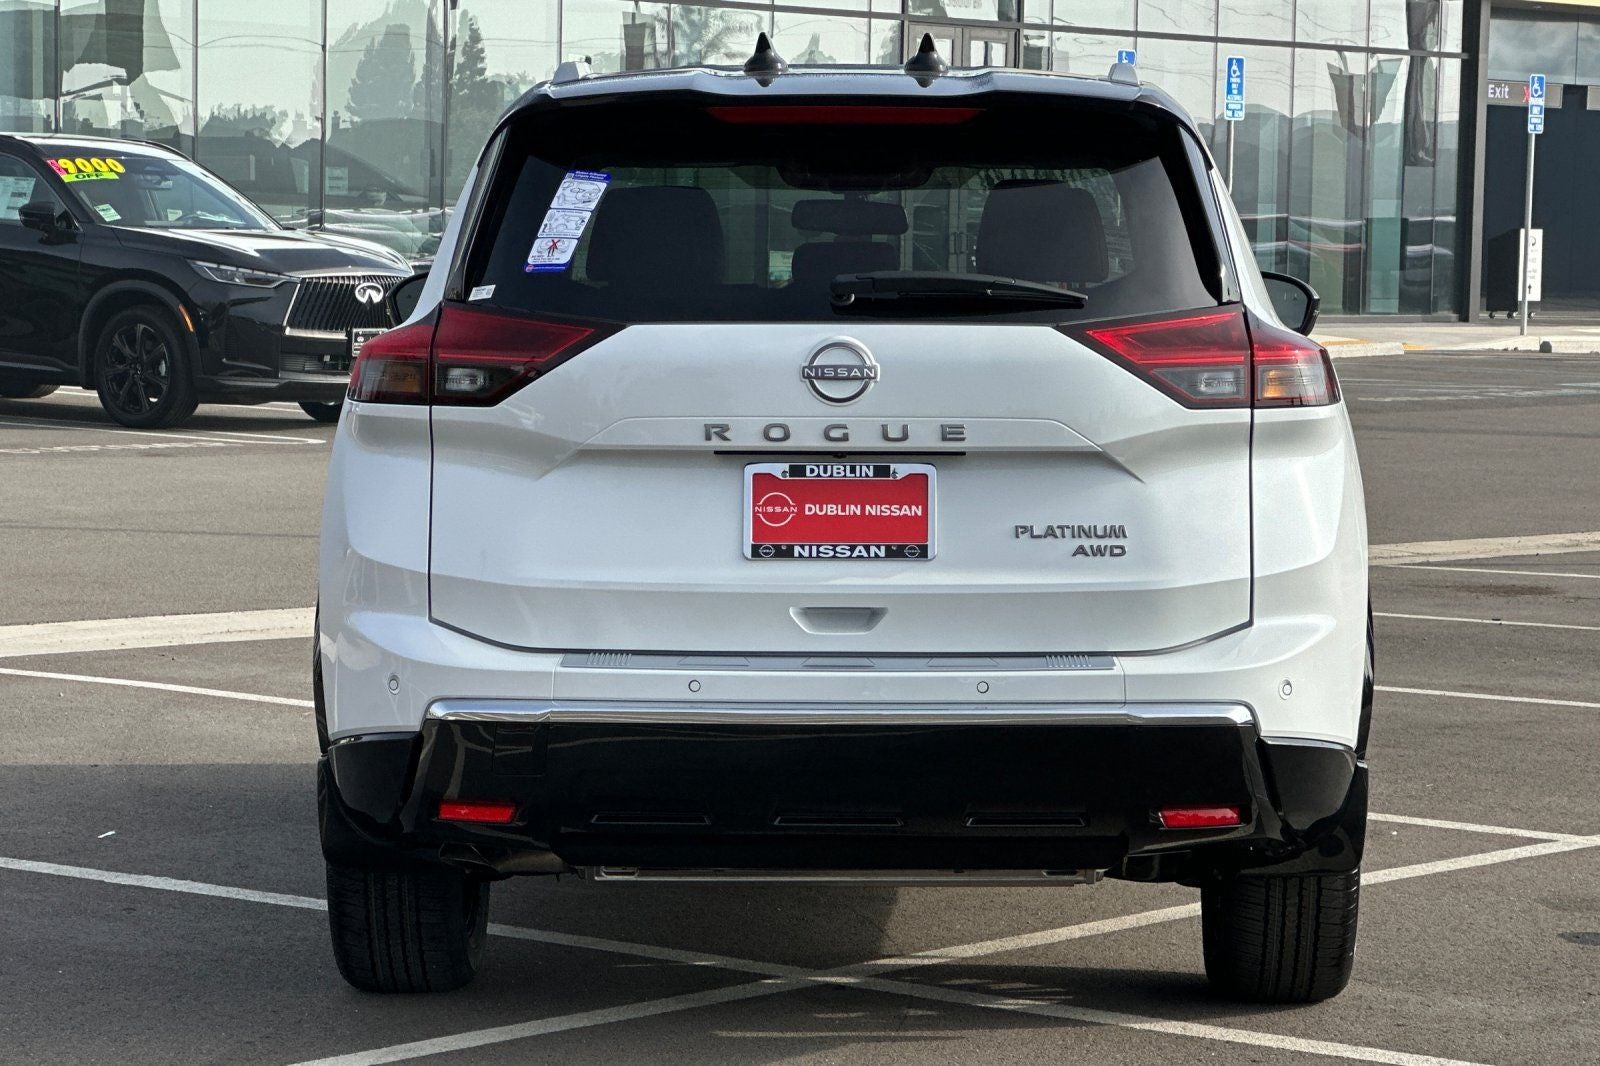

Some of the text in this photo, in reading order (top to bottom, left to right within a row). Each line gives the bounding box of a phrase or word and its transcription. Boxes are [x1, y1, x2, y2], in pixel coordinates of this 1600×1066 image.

[1488, 84, 1509, 98] Exit
[58, 157, 126, 174] 9000
[804, 367, 875, 378] NISSAN
[704, 422, 967, 442] ROGUE
[805, 465, 874, 477] DUBLIN
[804, 504, 922, 516] DUBLIN NISSAN
[1014, 525, 1128, 539] PLATINUM
[793, 545, 886, 557] NISSAN
[1072, 544, 1127, 557] AWD
